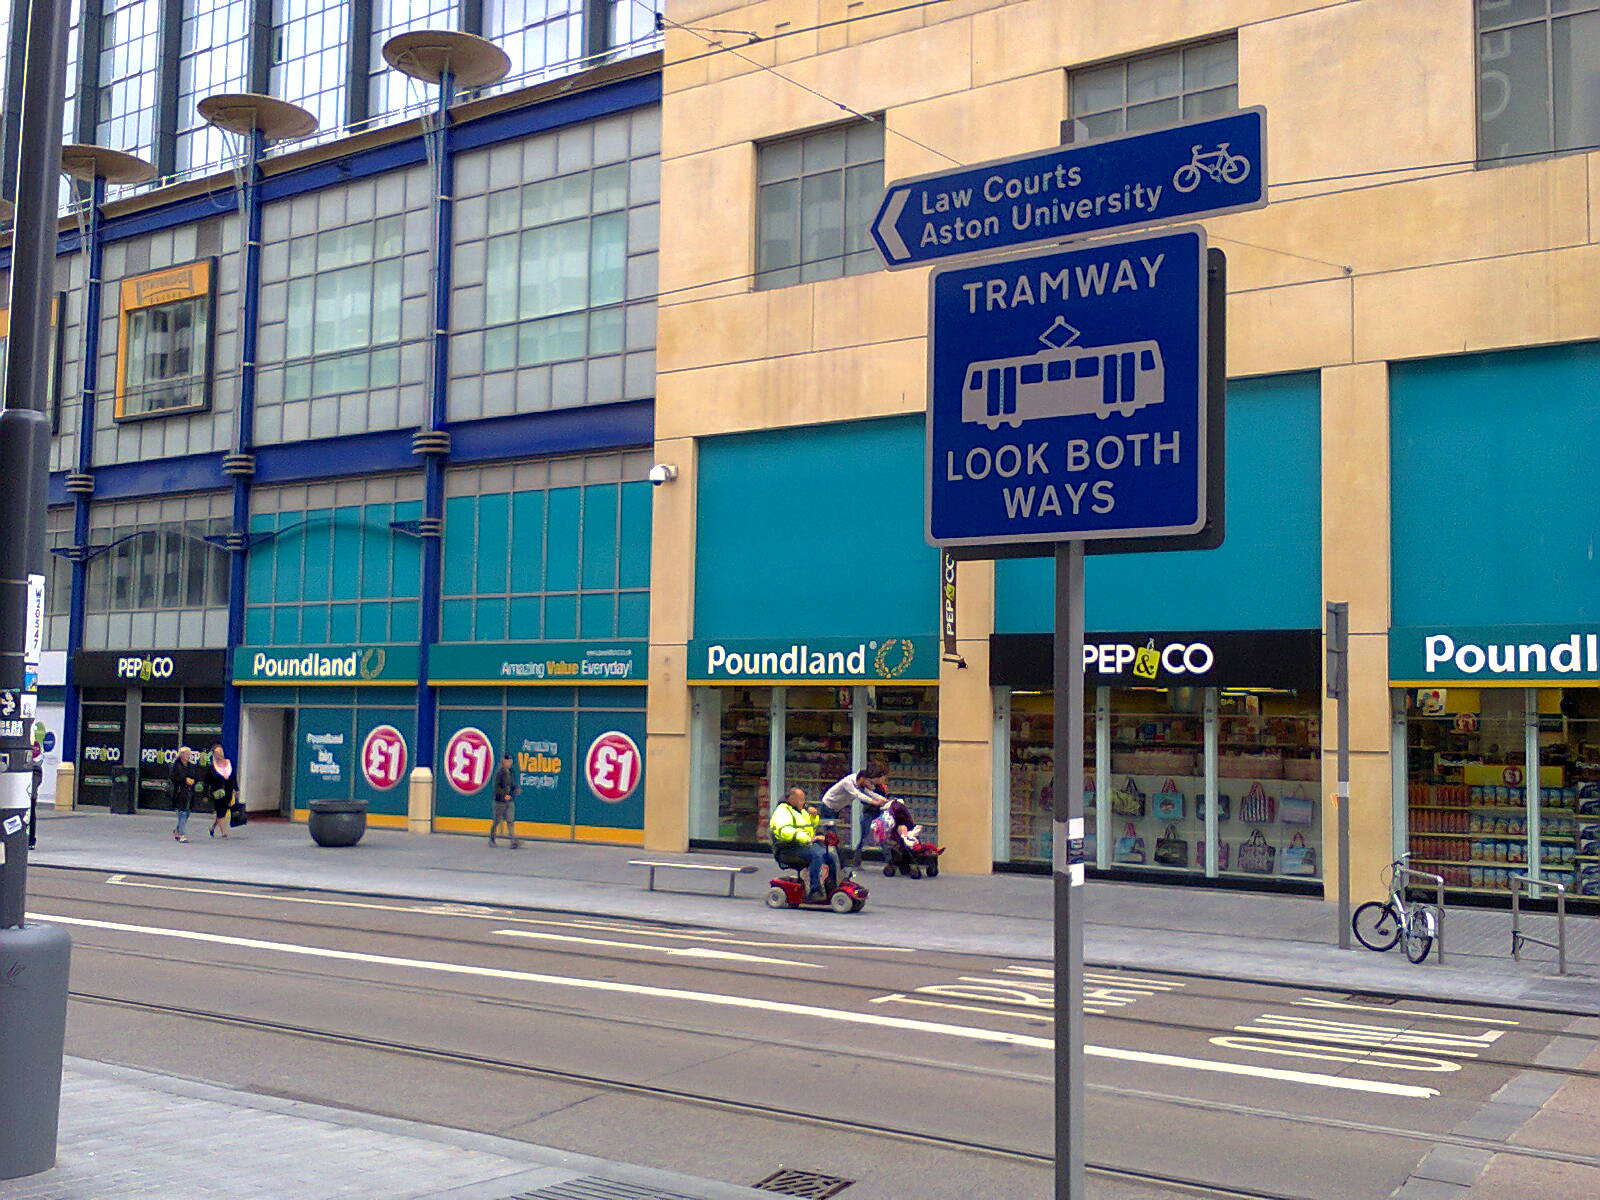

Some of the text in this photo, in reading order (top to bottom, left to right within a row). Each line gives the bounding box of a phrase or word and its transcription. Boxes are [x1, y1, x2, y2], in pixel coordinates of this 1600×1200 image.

[921, 162, 1082, 216] Law Courts
[920, 184, 1163, 248] Aston University
[962, 253, 1165, 314] TRAMWAY
[946, 430, 1181, 481] LOOK BOTH
[1002, 480, 1116, 519] WAYS
[253, 653, 357, 677] Poundland
[501, 662, 545, 678] Amazing
[546, 661, 580, 675] Value
[707, 644, 866, 675] Poundland
[1083, 643, 1214, 679] PEP&CO
[368, 739, 402, 783] £1
[451, 741, 487, 784] £1
[518, 752, 562, 773] Value
[594, 745, 633, 793] £1
[1208, 997, 1520, 1071] ONLY
